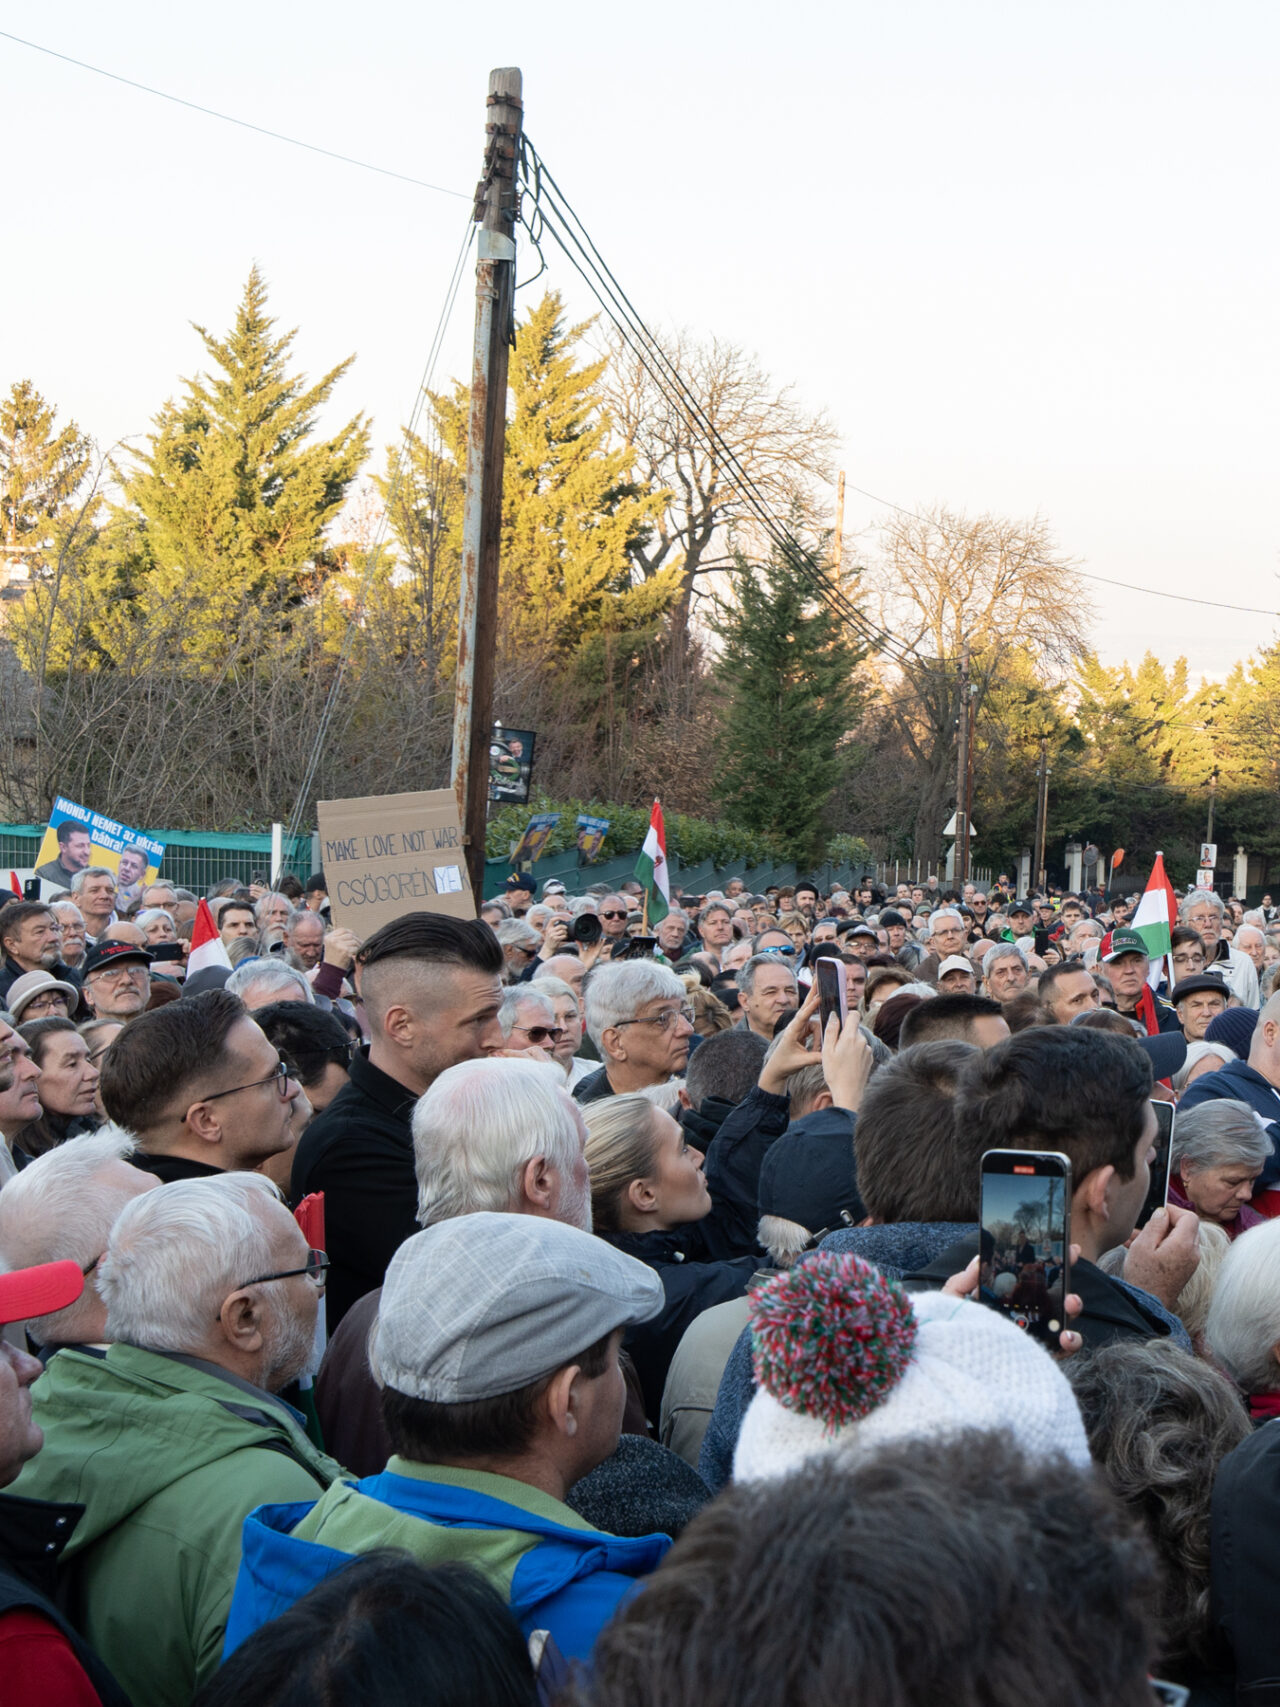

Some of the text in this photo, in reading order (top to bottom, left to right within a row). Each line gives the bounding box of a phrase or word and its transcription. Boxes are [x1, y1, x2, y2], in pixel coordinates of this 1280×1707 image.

[57, 799, 164, 856] MONDJ NEMET az ukrán
[91, 829, 124, 852] bábra!
[326, 826, 459, 862] MAKE LOVE NOT WAR
